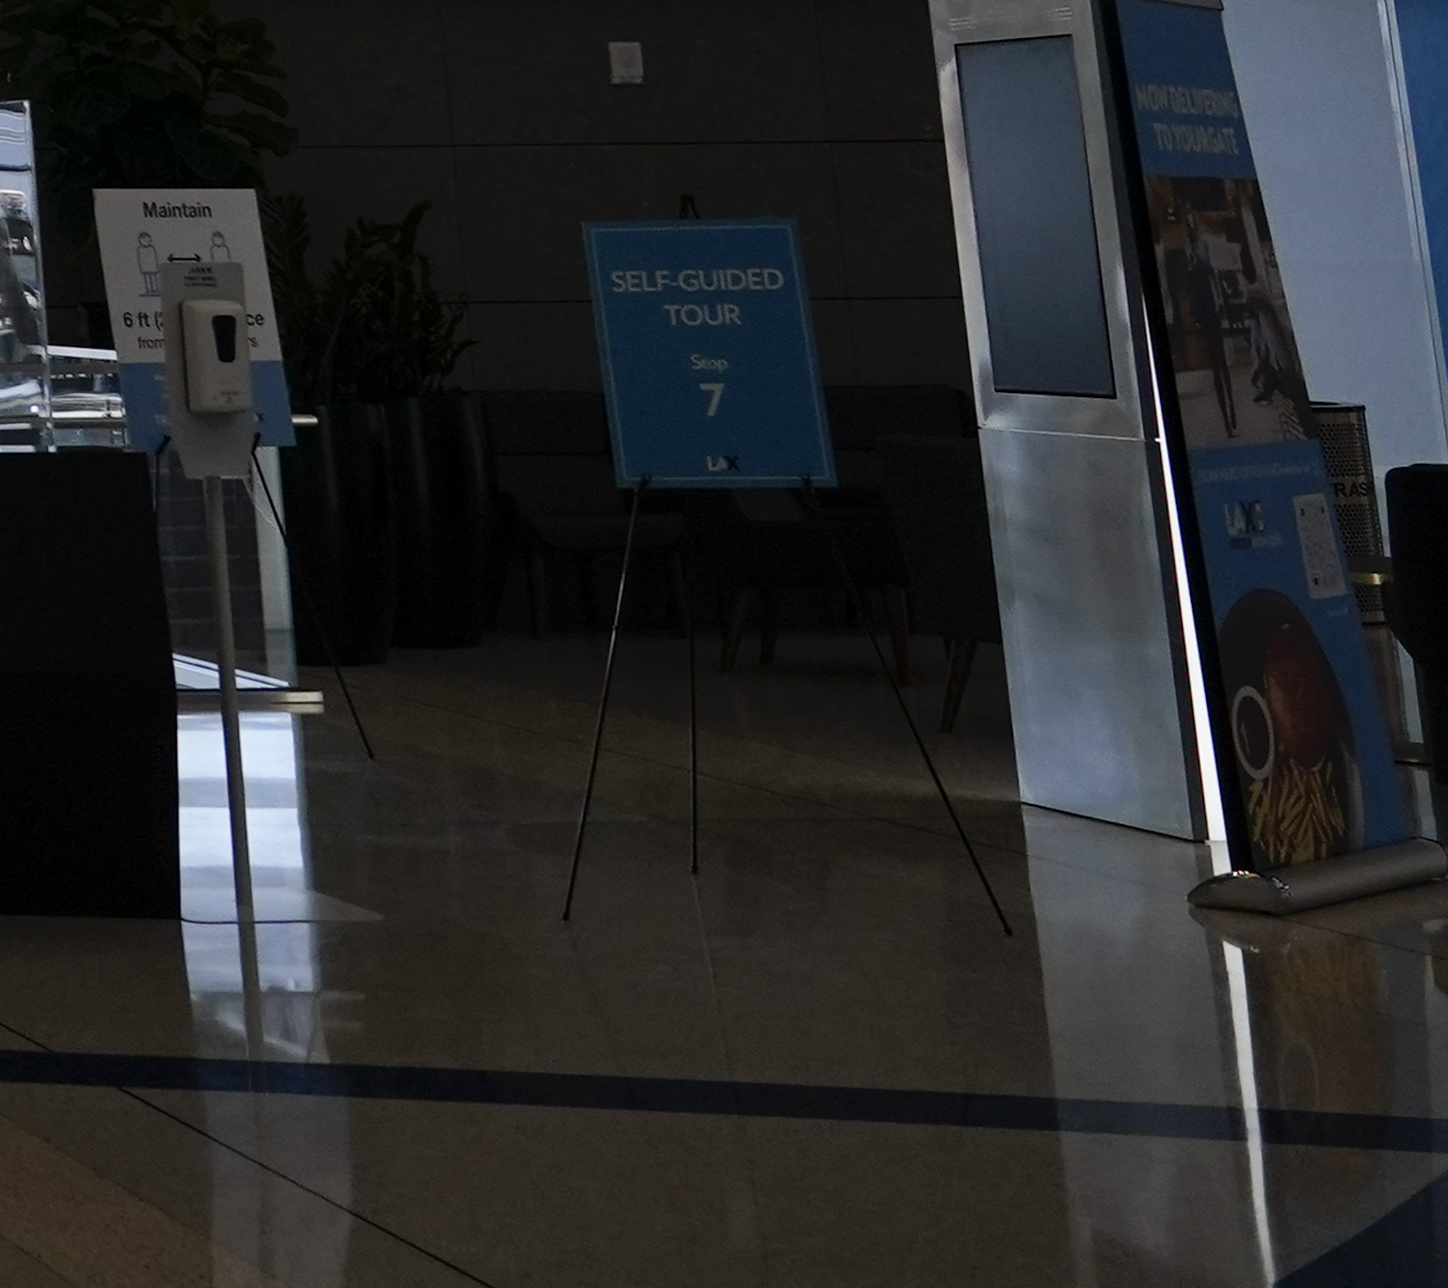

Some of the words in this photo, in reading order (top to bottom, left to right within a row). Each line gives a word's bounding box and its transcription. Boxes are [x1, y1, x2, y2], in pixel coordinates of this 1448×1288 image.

[143, 201, 213, 219] Maintain
[611, 268, 785, 293] SELF-GUIDED
[123, 311, 133, 328] 6
[137, 310, 151, 328] ft
[662, 304, 742, 327] TOUR
[690, 353, 729, 374] Stop
[698, 382, 725, 417] 7
[706, 455, 740, 472] LAX
